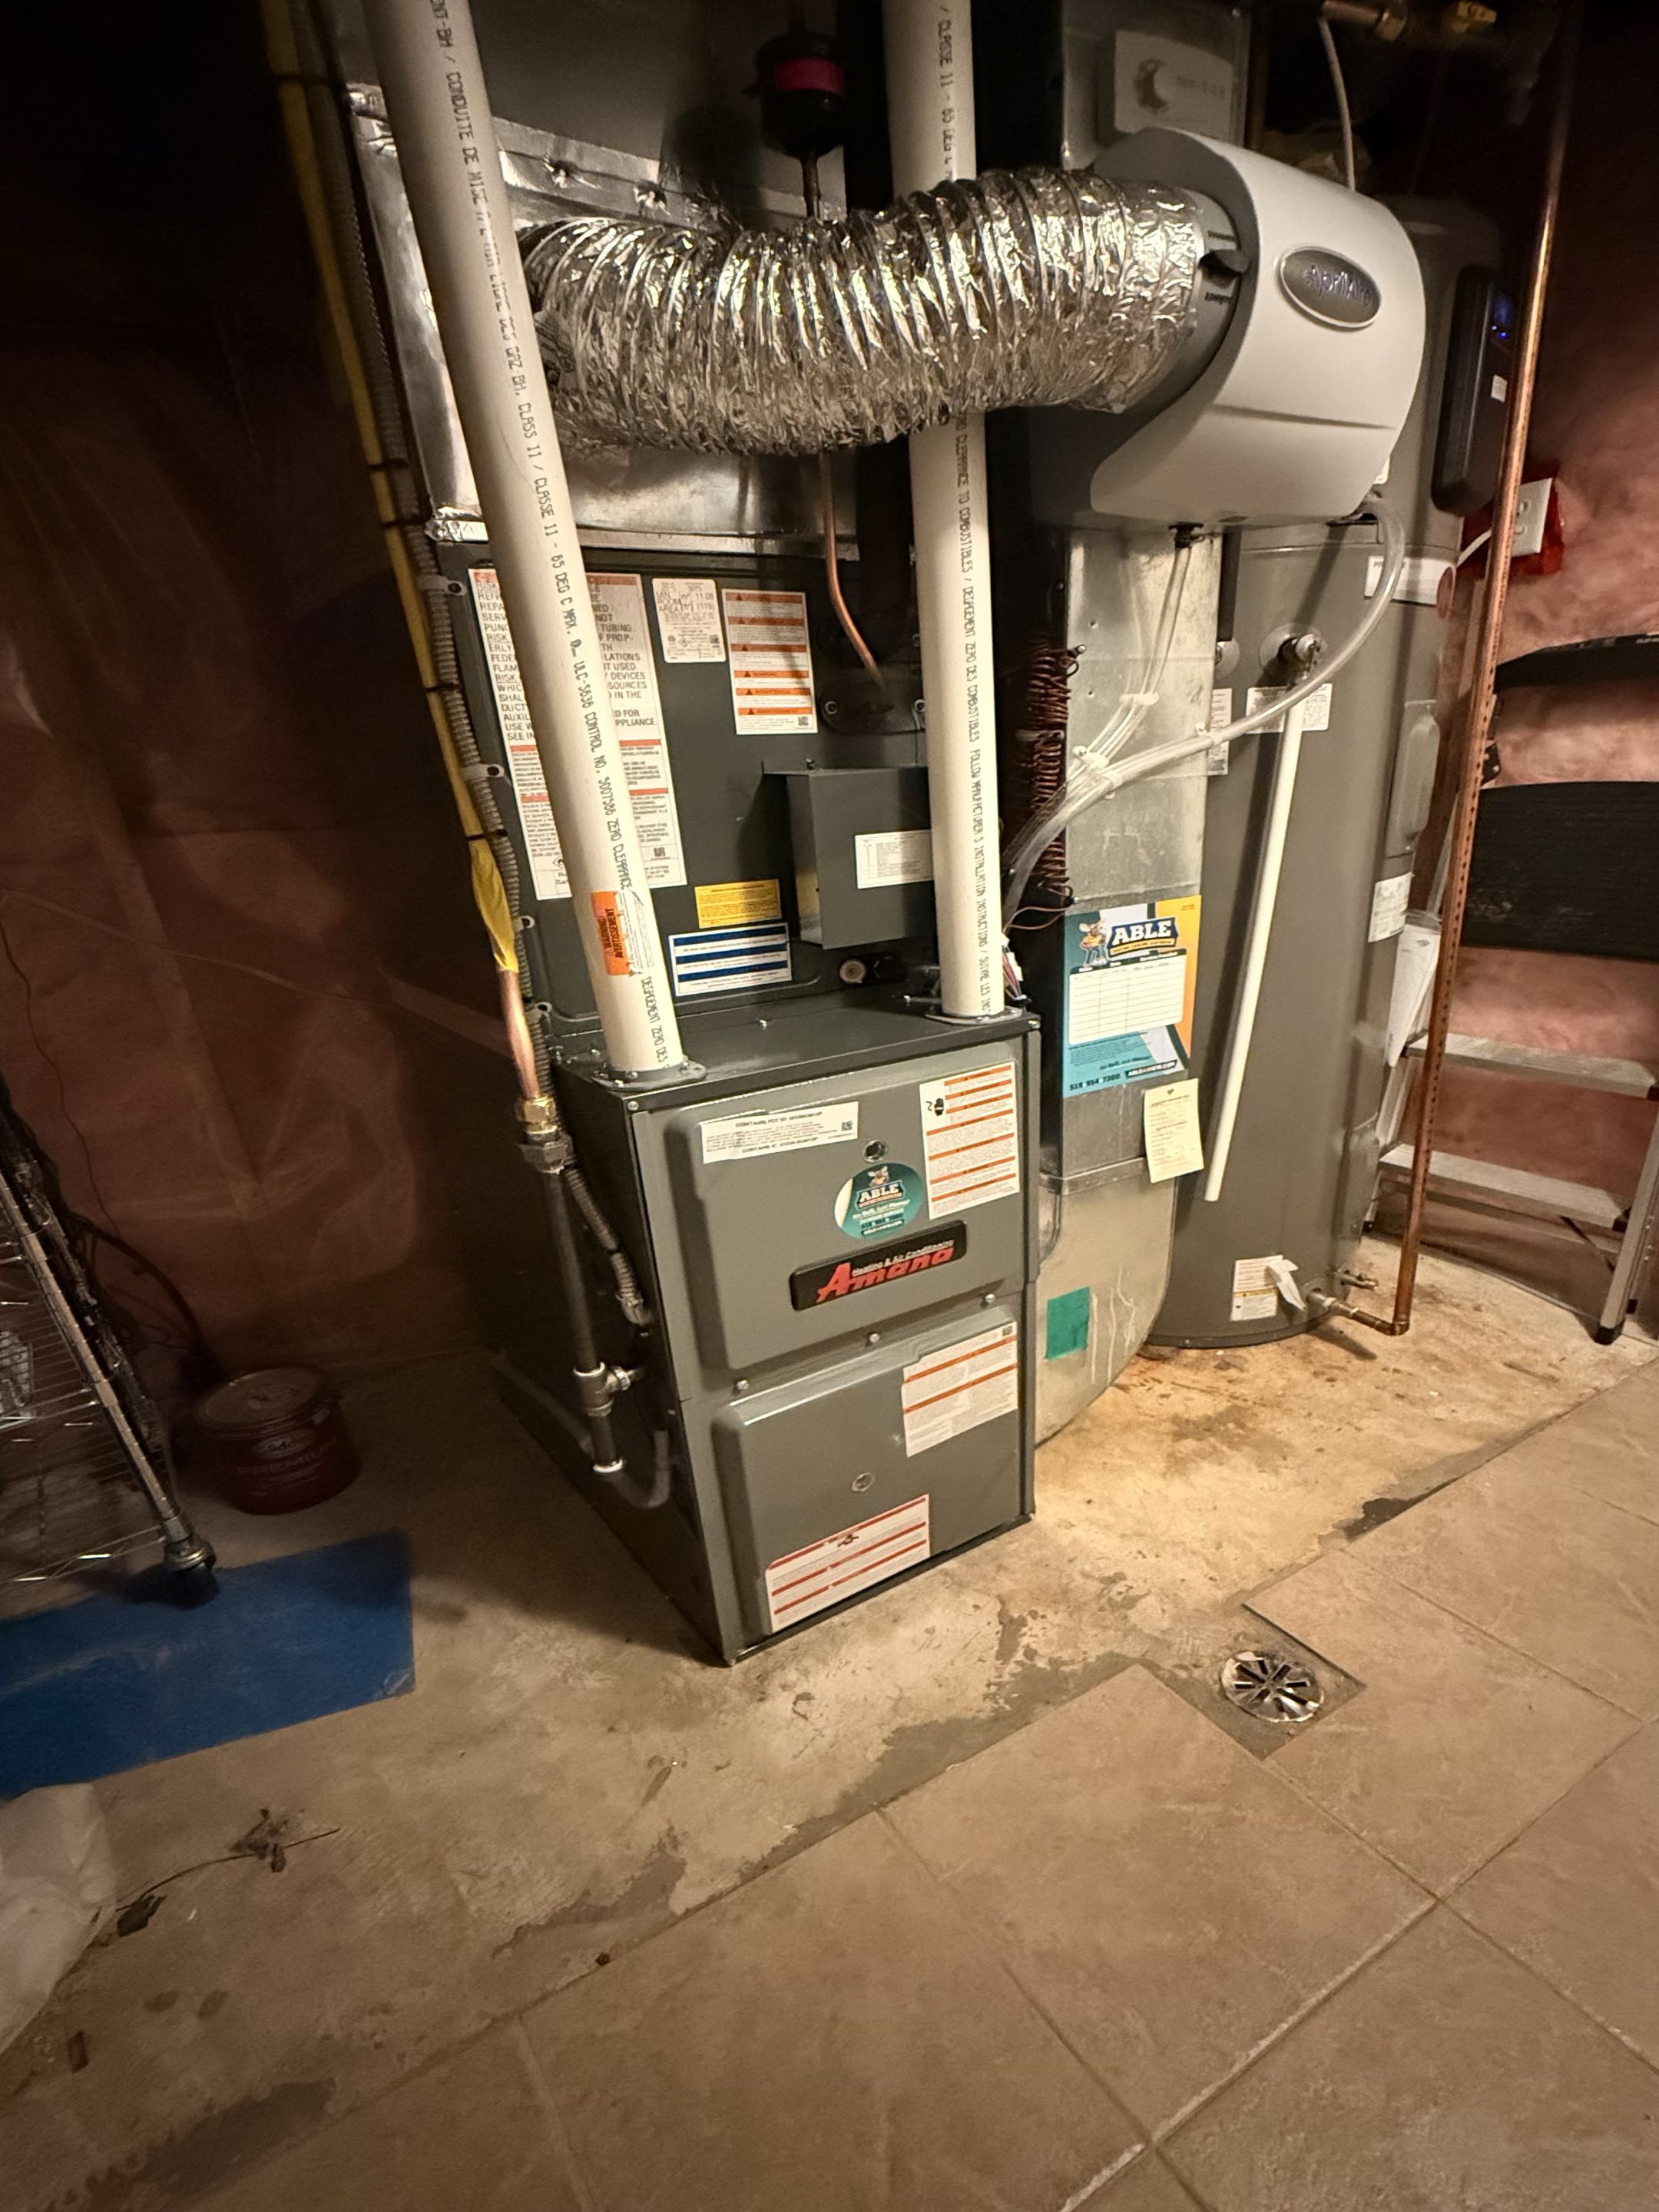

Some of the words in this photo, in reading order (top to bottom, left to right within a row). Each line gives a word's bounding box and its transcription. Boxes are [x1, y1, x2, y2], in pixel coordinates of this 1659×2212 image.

[446, 71, 474, 140] CONDUITE
[462, 146, 479, 166] DE
[518, 402, 537, 439] CLASS
[534, 477, 555, 518] CLASSE
[959, 490, 970, 504] TO
[959, 507, 973, 573] COMBUSTIBLES
[555, 572, 570, 594] DEG
[965, 641, 977, 663] ZERO
[608, 681, 647, 690] SOURCES
[966, 665, 978, 681] DES
[967, 684, 980, 743] COMBUSTIBLES
[584, 711, 602, 753] CONTROL
[970, 749, 981, 778] FOLLOW
[608, 819, 622, 842] ZERO
[613, 844, 633, 890] CLEARANCE
[974, 846, 986, 897] INSTALLATION
[1111, 920, 1172, 946] ABLE
[651, 1025, 665, 1046] ZERO
[656, 1046, 669, 1063] DES
[859, 1183, 899, 1203] ABLE
[816, 1246, 955, 1303] Amana
